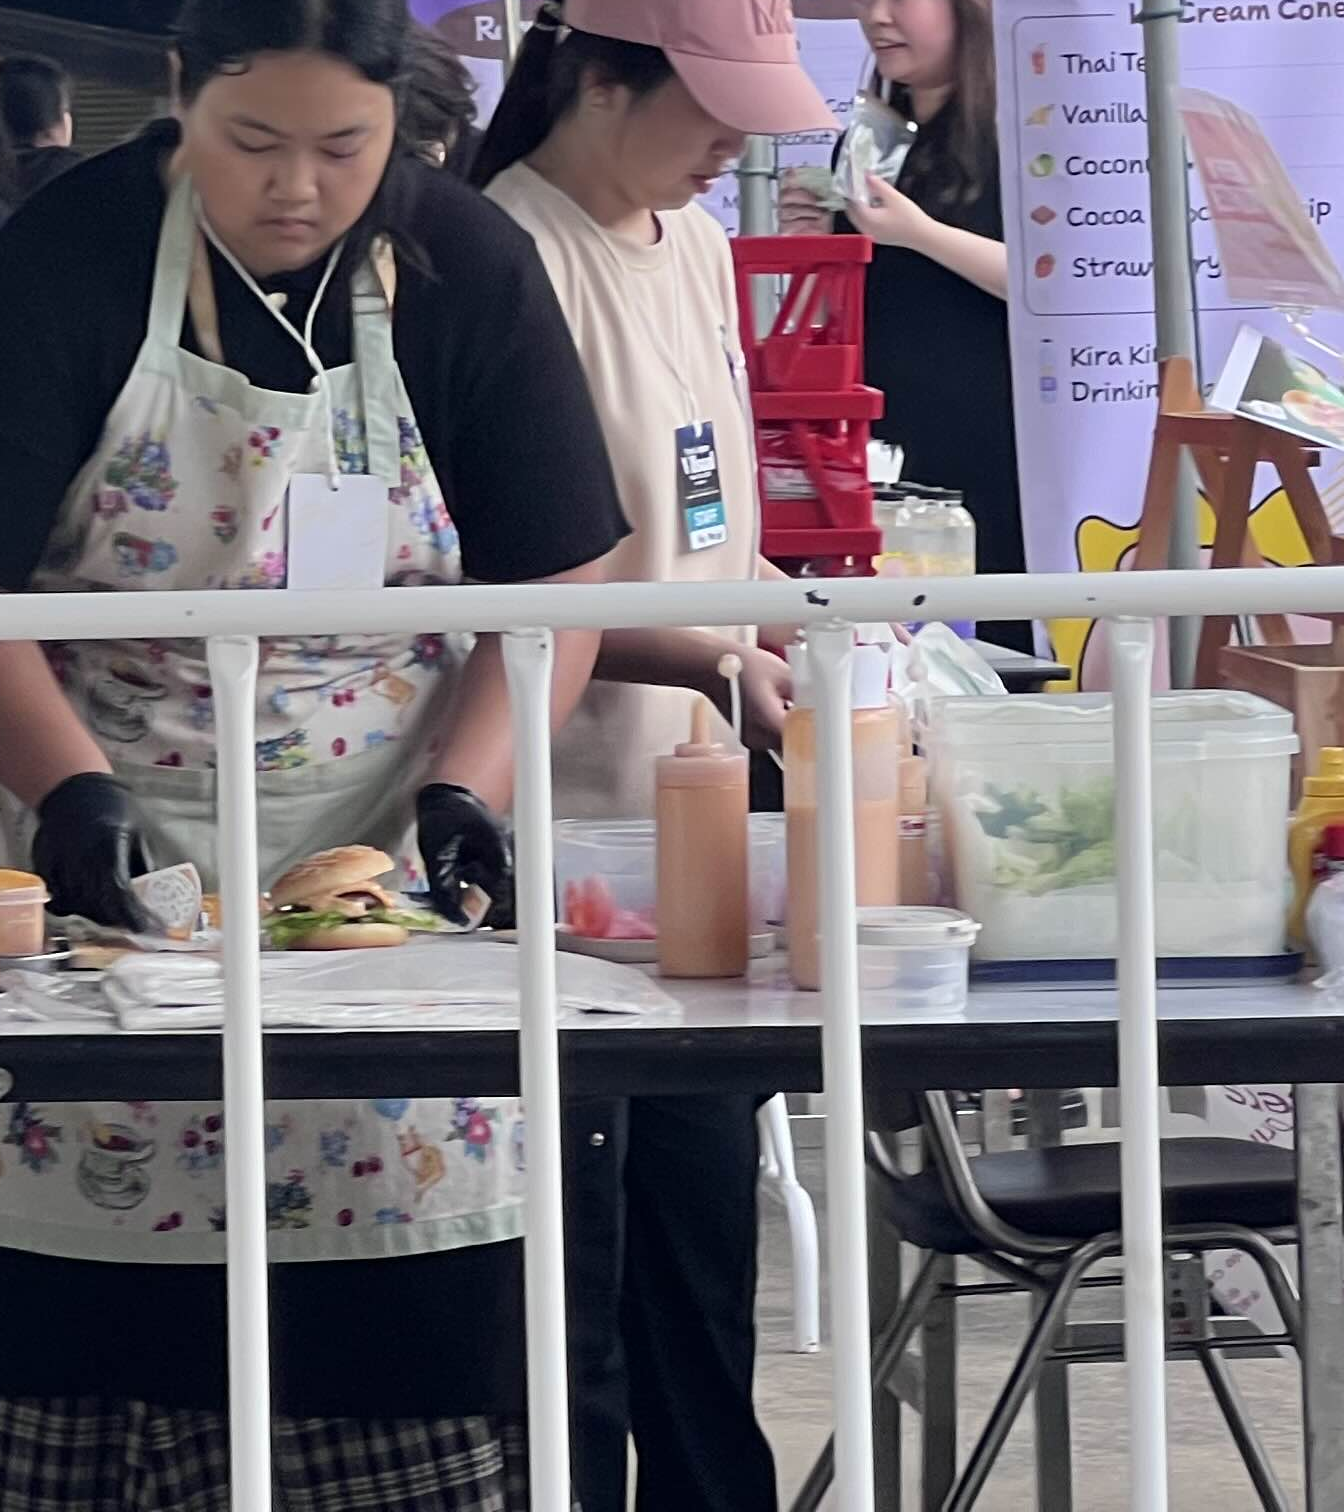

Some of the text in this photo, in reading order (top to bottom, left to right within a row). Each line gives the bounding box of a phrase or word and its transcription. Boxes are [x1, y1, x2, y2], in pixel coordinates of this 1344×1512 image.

[1061, 52, 1116, 74] Thai
[1066, 206, 1146, 227] Cocoa
[1071, 345, 1123, 367] Kira
